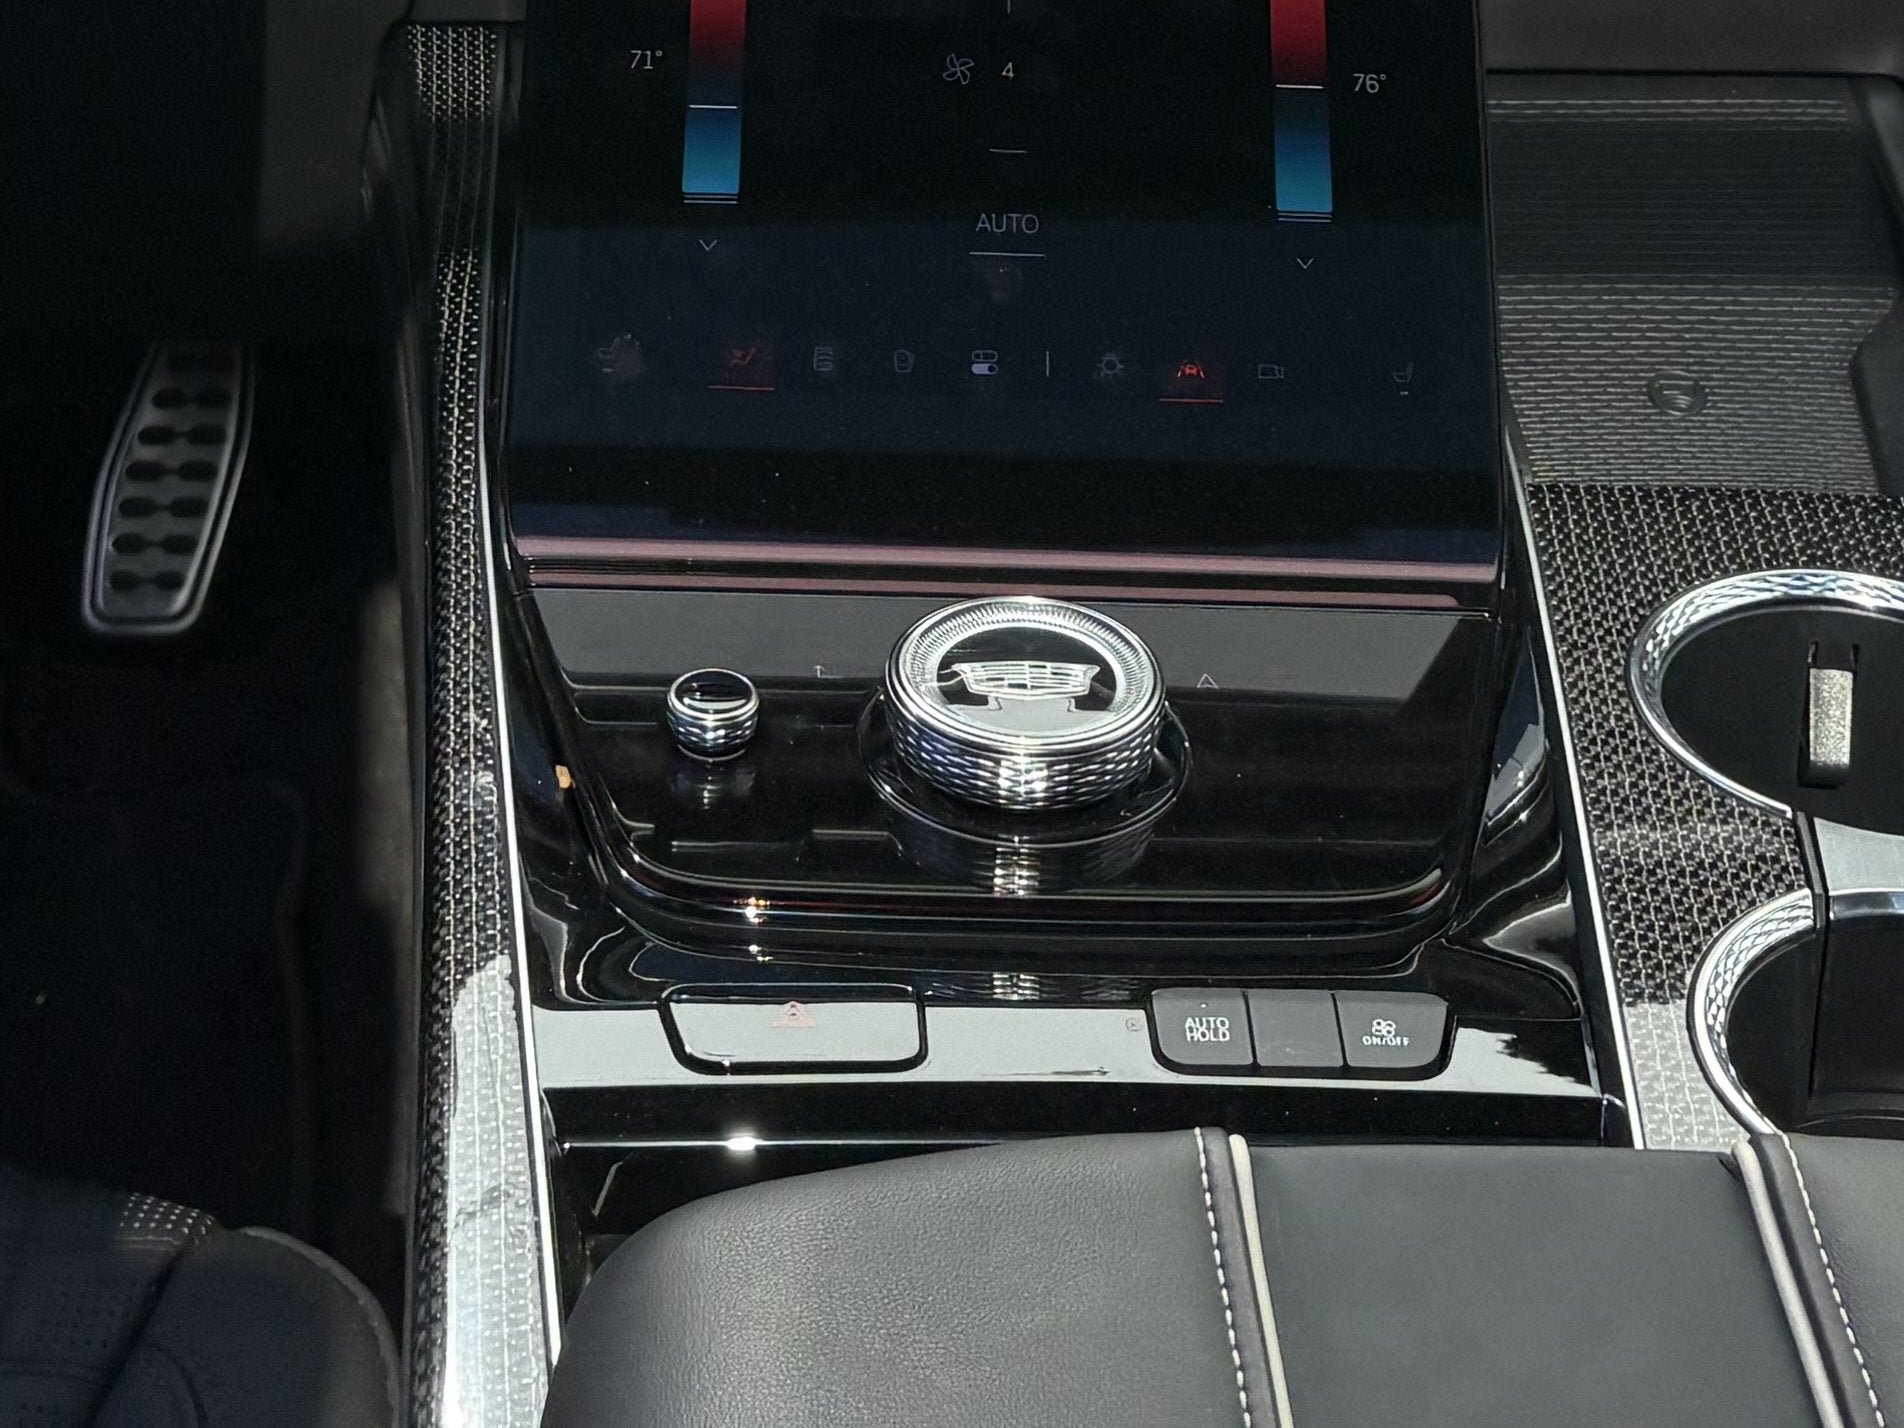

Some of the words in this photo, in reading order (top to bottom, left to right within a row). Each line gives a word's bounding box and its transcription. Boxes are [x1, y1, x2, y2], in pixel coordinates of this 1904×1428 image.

[630, 48, 663, 70] 71°
[1001, 61, 1015, 81] 4
[1352, 72, 1388, 94] 76°
[975, 213, 1039, 234] AUTO
[1184, 1016, 1229, 1030] AUTO
[1186, 1027, 1231, 1042] HOLD
[1362, 1035, 1410, 1048] ON/OFF
